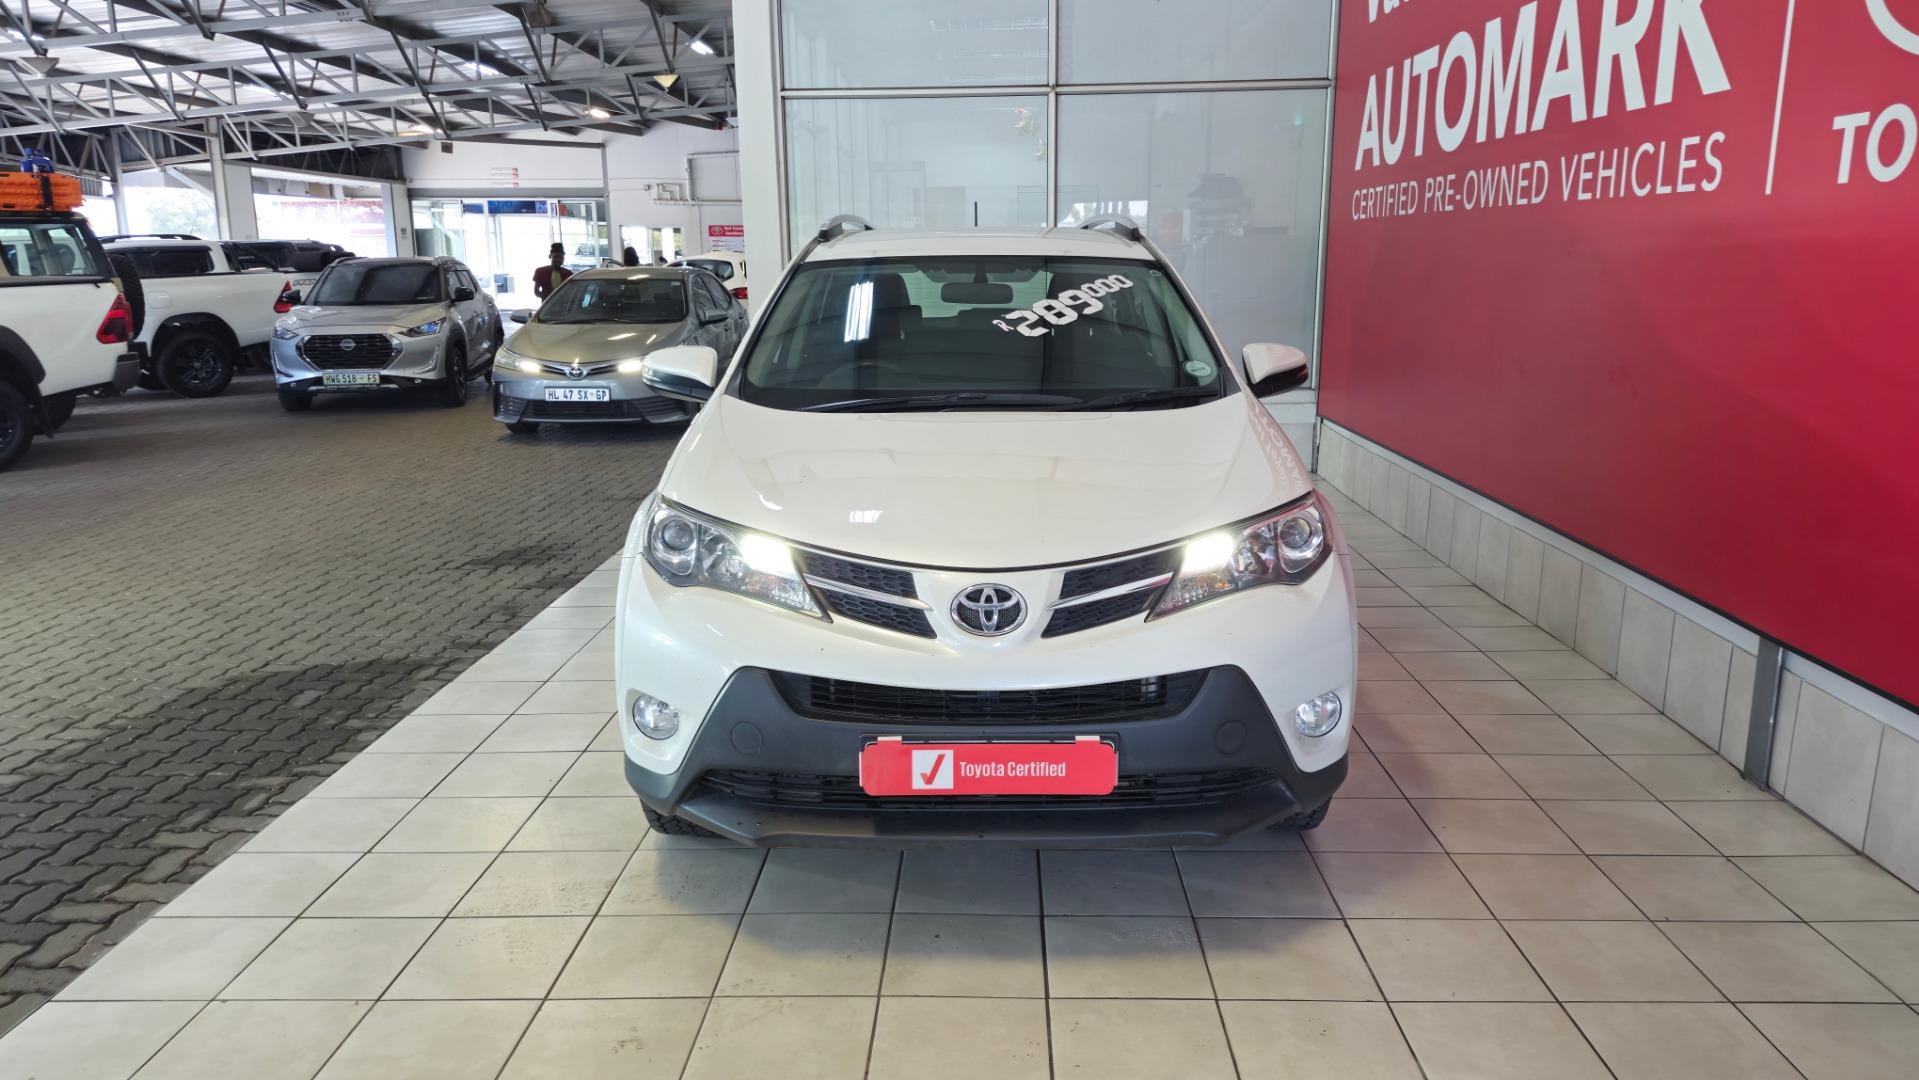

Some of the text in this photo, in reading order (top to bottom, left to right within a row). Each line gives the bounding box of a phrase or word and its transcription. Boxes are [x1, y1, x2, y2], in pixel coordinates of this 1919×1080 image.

[1355, 0, 1731, 170] AUTOMARK
[1352, 131, 1725, 220] CERTIFIED PRE-OWNED VEHICLES
[548, 389, 559, 400] HL
[563, 389, 574, 400] 47
[959, 761, 1066, 779] Toyota Certified
